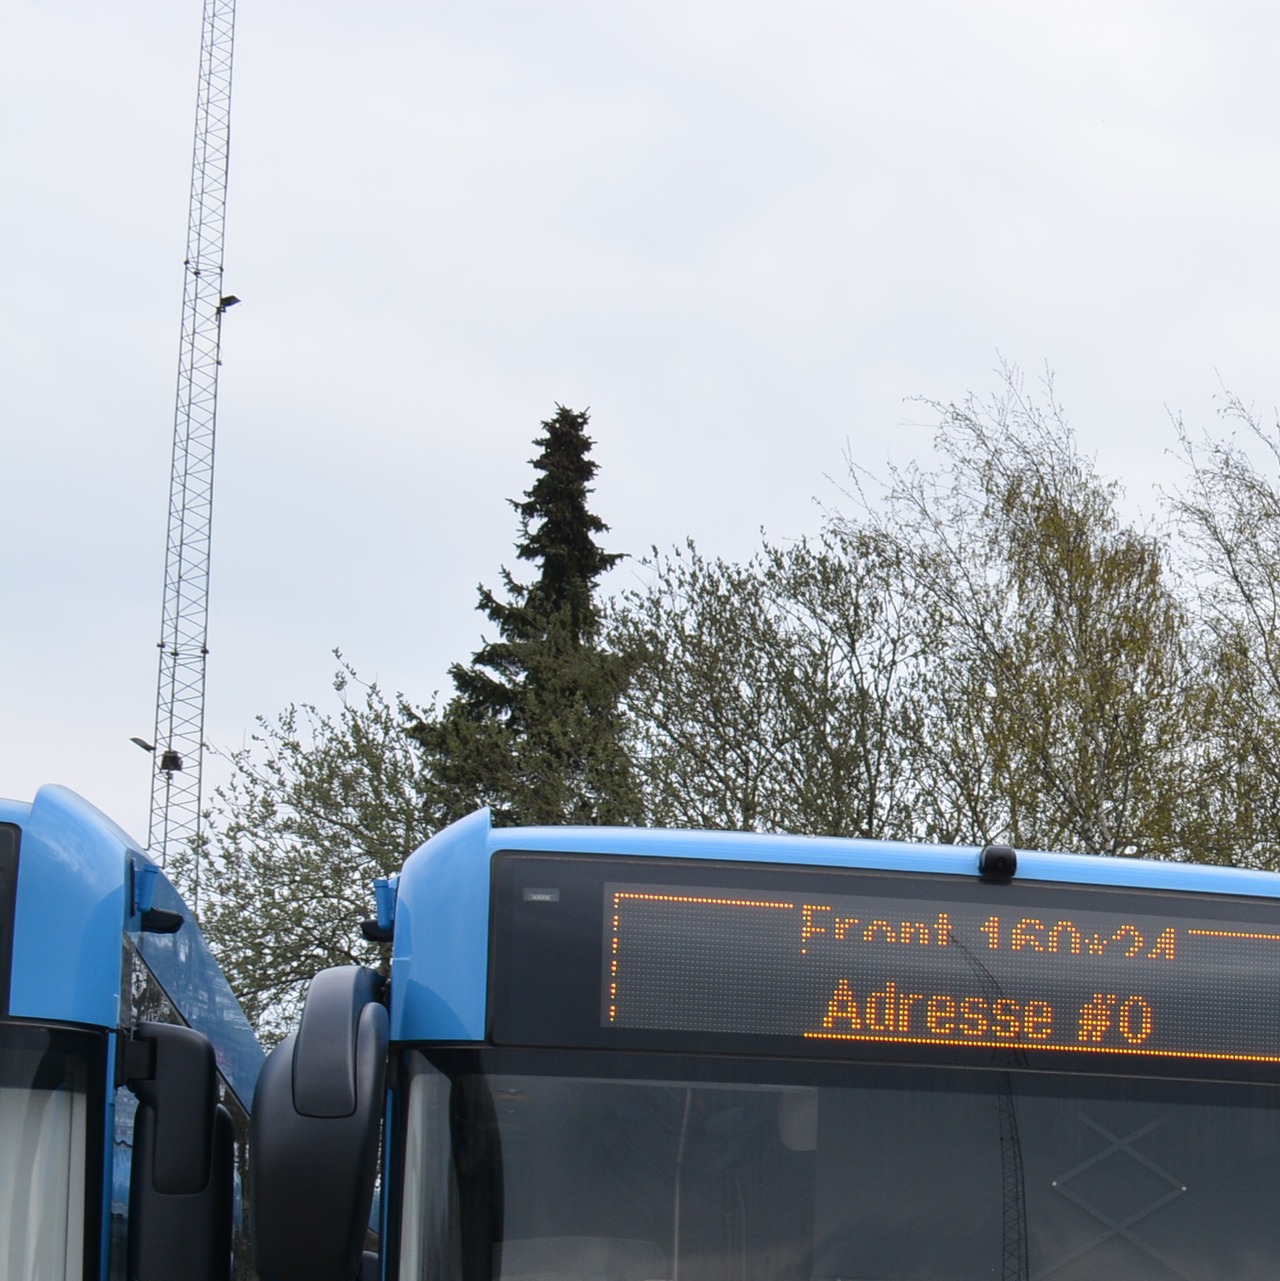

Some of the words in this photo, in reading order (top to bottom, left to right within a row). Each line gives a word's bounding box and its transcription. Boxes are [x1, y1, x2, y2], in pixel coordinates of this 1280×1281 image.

[801, 905, 953, 949] Front
[822, 978, 1053, 1040] Adresse
[1077, 992, 1153, 1044] #0
